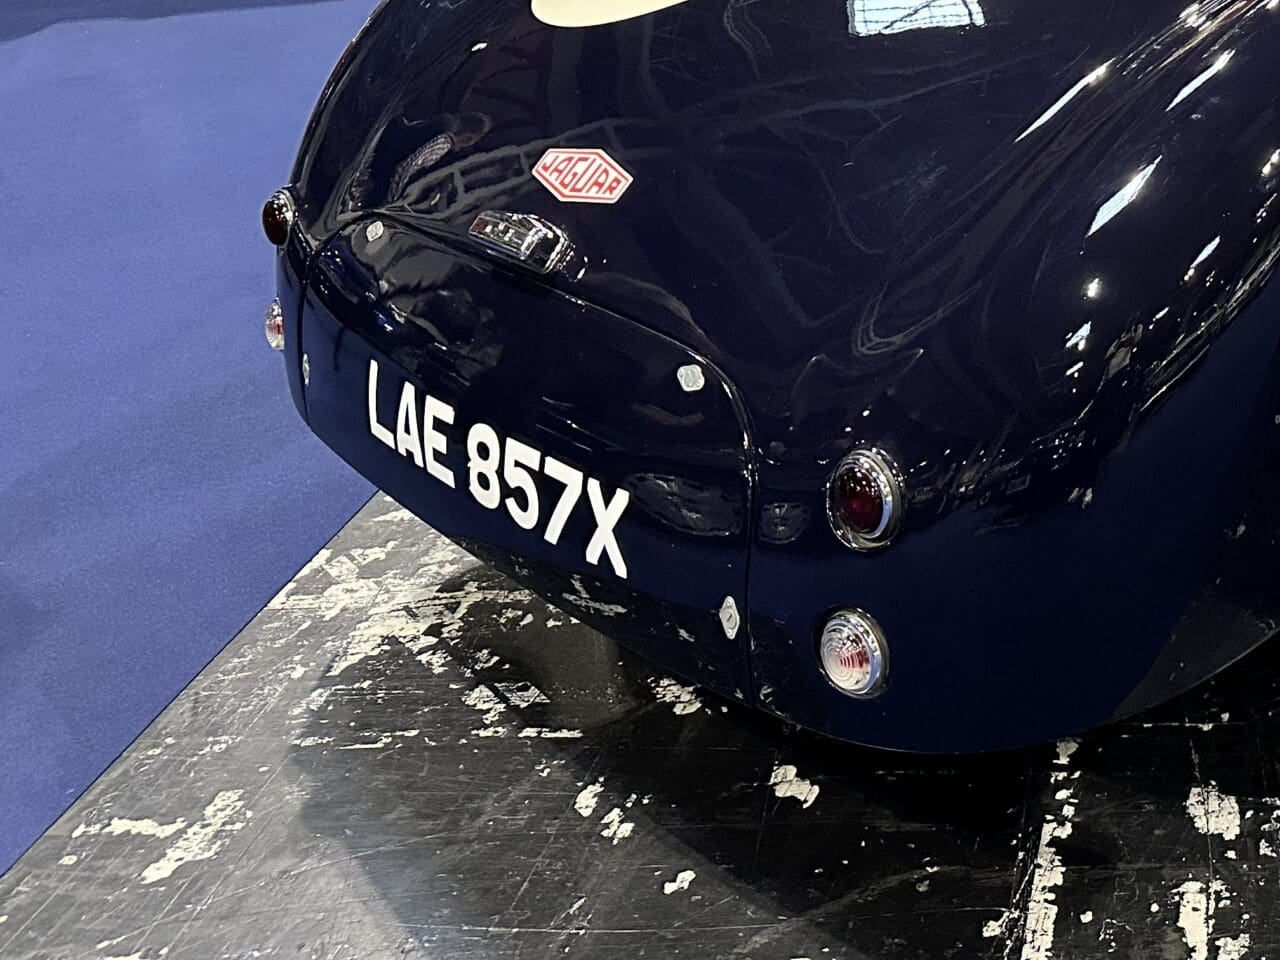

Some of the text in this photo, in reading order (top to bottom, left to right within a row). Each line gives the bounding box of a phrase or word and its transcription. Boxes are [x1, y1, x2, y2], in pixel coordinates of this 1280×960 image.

[541, 155, 623, 196] JAGUAR
[368, 359, 631, 580] LAE 857X
